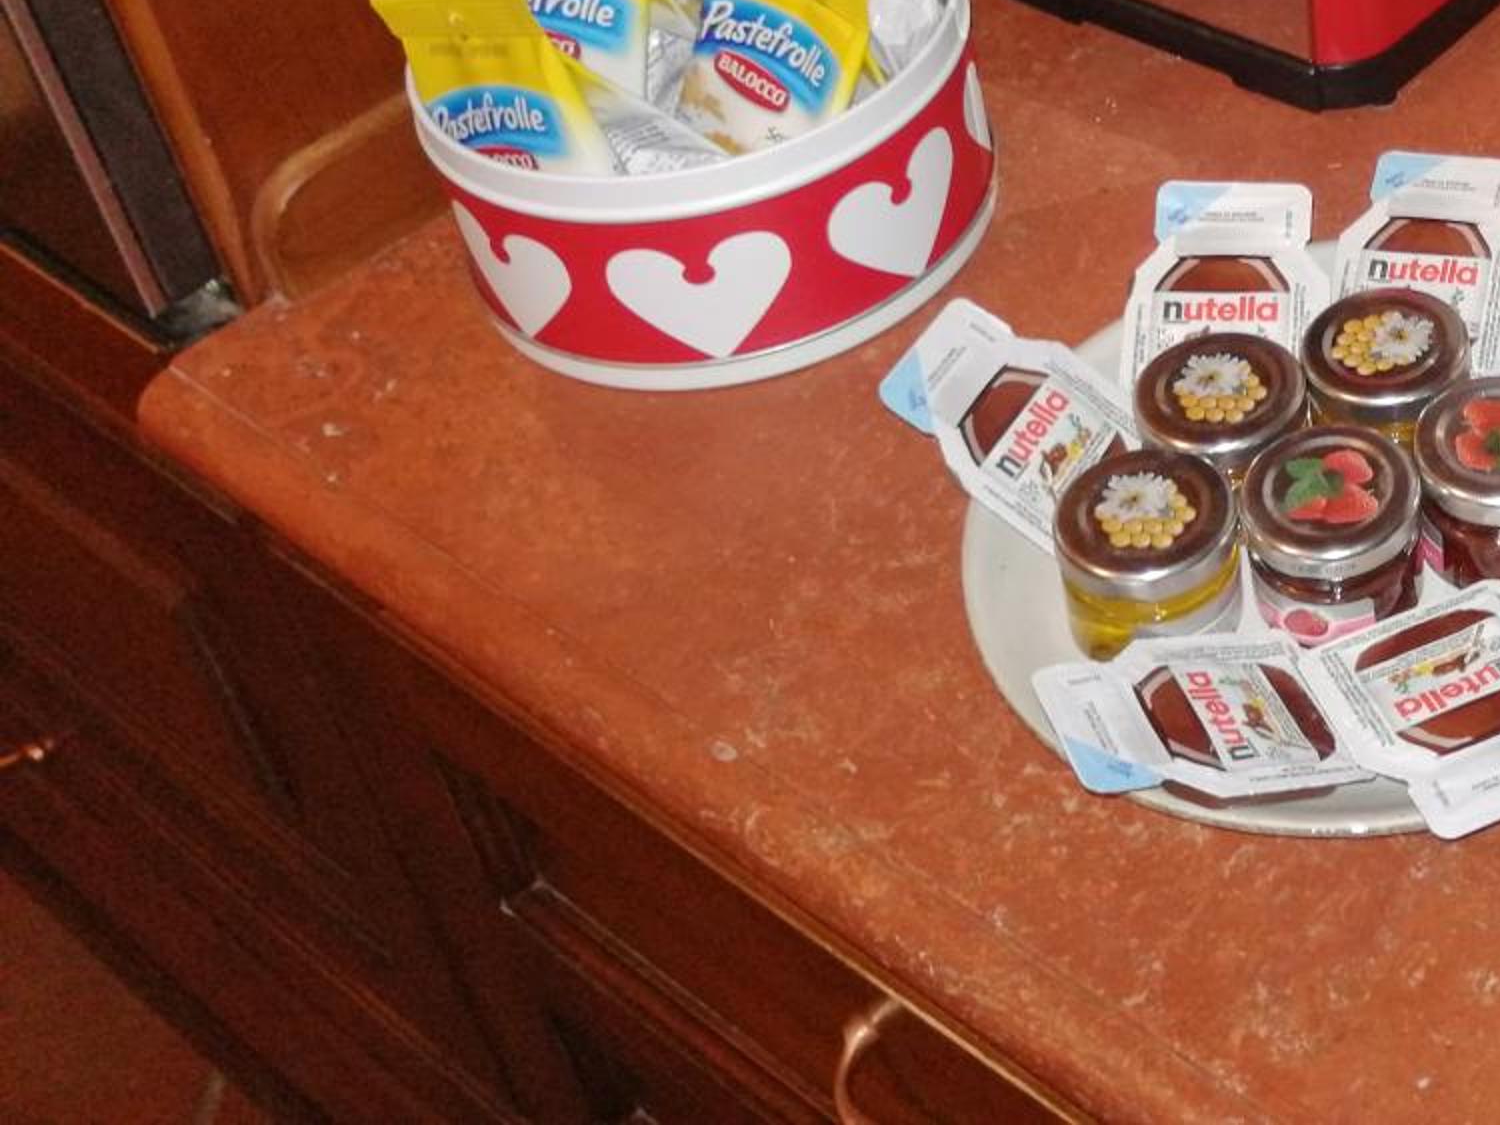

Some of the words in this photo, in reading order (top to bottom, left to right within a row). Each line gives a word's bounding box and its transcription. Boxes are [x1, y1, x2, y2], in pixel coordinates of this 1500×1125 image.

[718, 53, 788, 107] BALOCCO
[1369, 257, 1479, 286] nutella
[1163, 296, 1279, 322] nutella
[997, 388, 1070, 477] nutella
[1186, 671, 1260, 761] nutella
